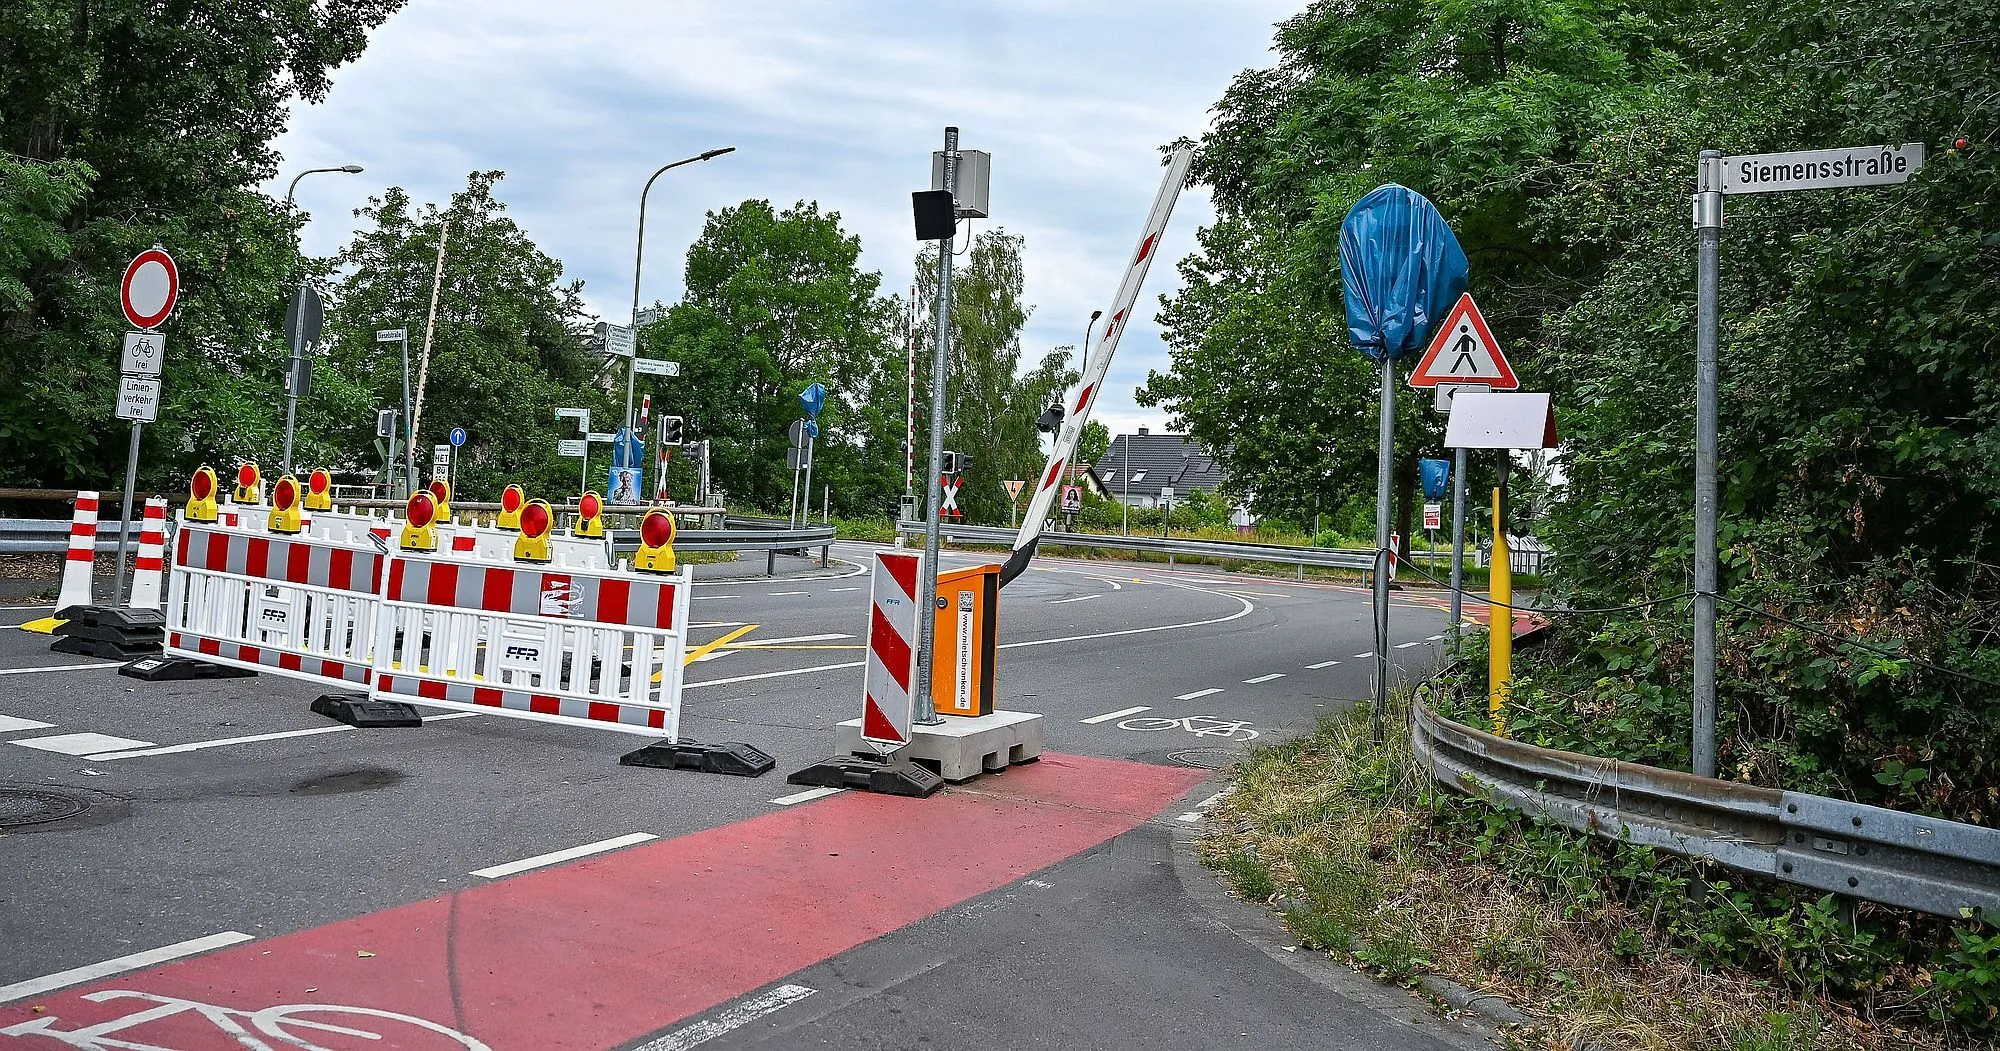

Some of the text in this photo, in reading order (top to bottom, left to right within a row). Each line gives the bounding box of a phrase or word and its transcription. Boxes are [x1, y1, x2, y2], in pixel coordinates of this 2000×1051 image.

[1741, 146, 1907, 185] Siemensstraße
[135, 360, 148, 369] frei
[126, 380, 153, 392] Linien-
[123, 394, 153, 405] verkehr
[130, 406, 143, 416] frei
[1011, 481, 1016, 493] 4
[262, 609, 287, 623] FFR
[505, 646, 539, 662] FFR
[959, 613, 969, 708] www.mietschranken.de
